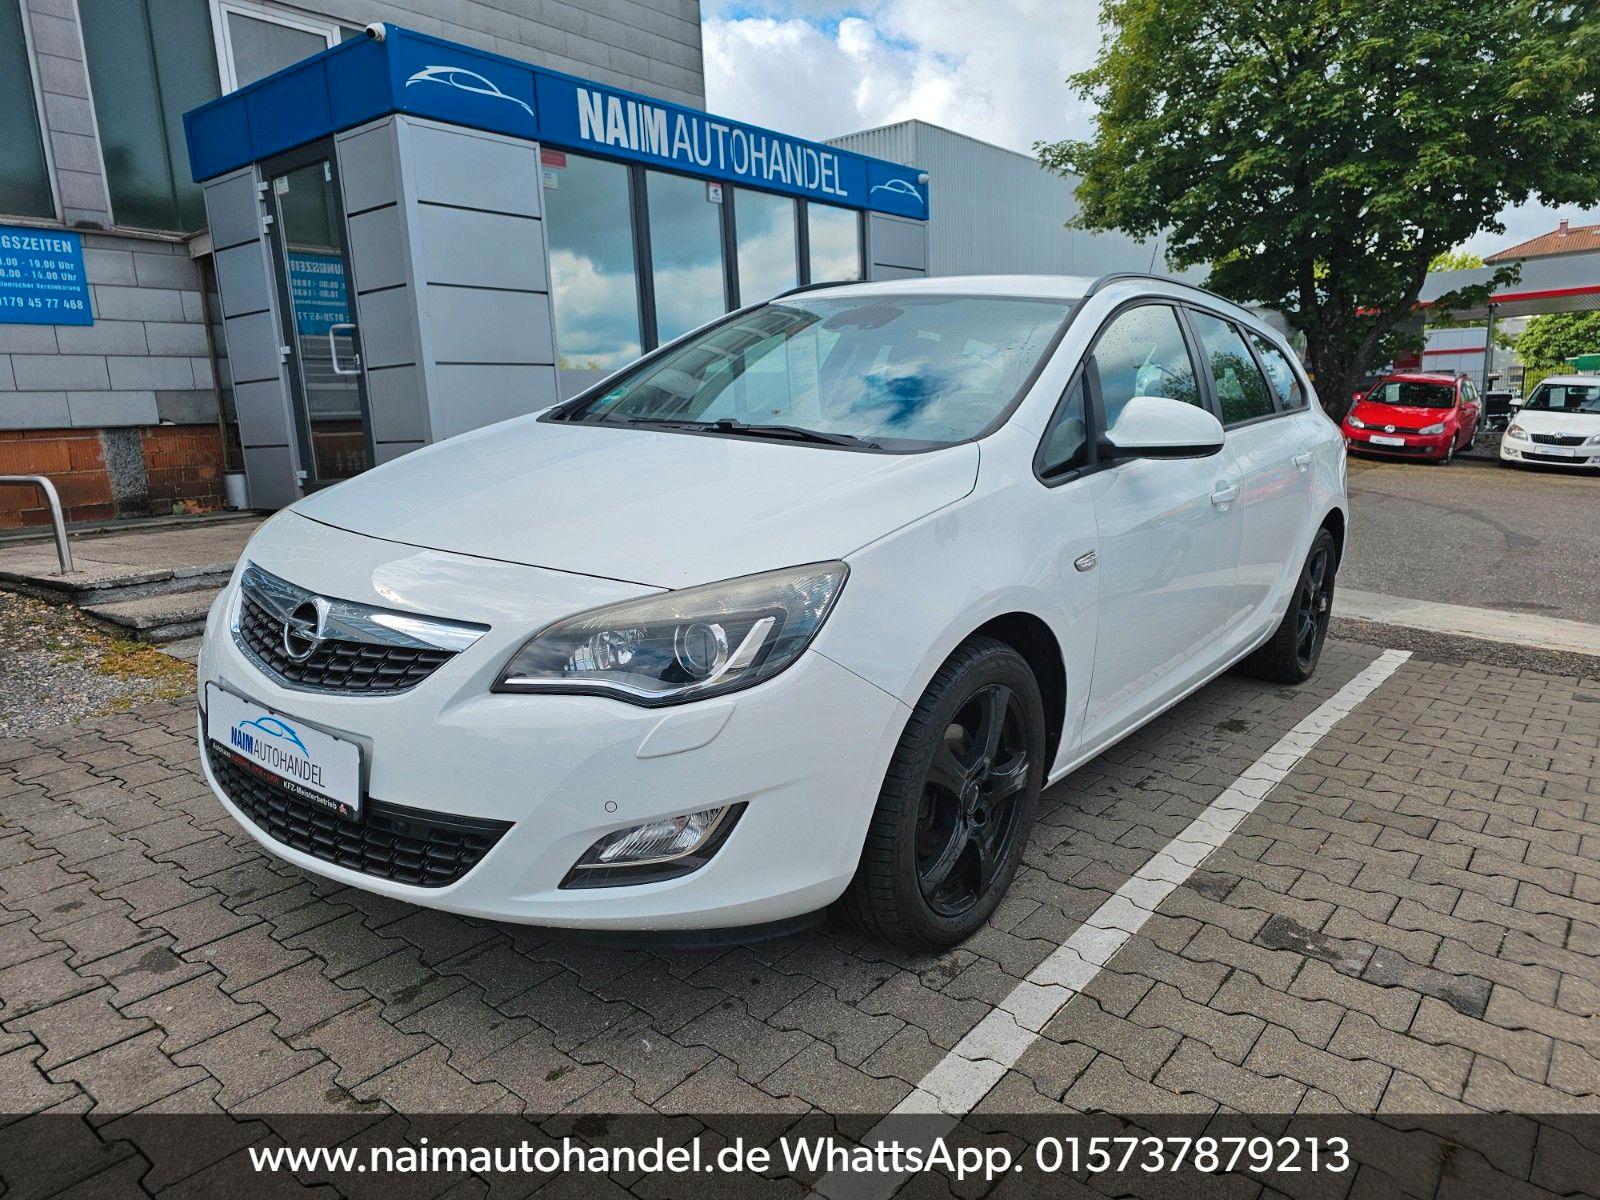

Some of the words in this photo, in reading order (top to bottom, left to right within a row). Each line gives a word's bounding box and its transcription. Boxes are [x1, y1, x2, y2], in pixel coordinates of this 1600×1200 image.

[29, 259, 55, 269] 19.00
[58, 261, 75, 271] Uhr
[32, 270, 58, 280] 14.00
[61, 272, 77, 281] Uhr
[28, 298, 42, 308] 45
[45, 298, 59, 308] 77
[63, 300, 83, 310] 468
